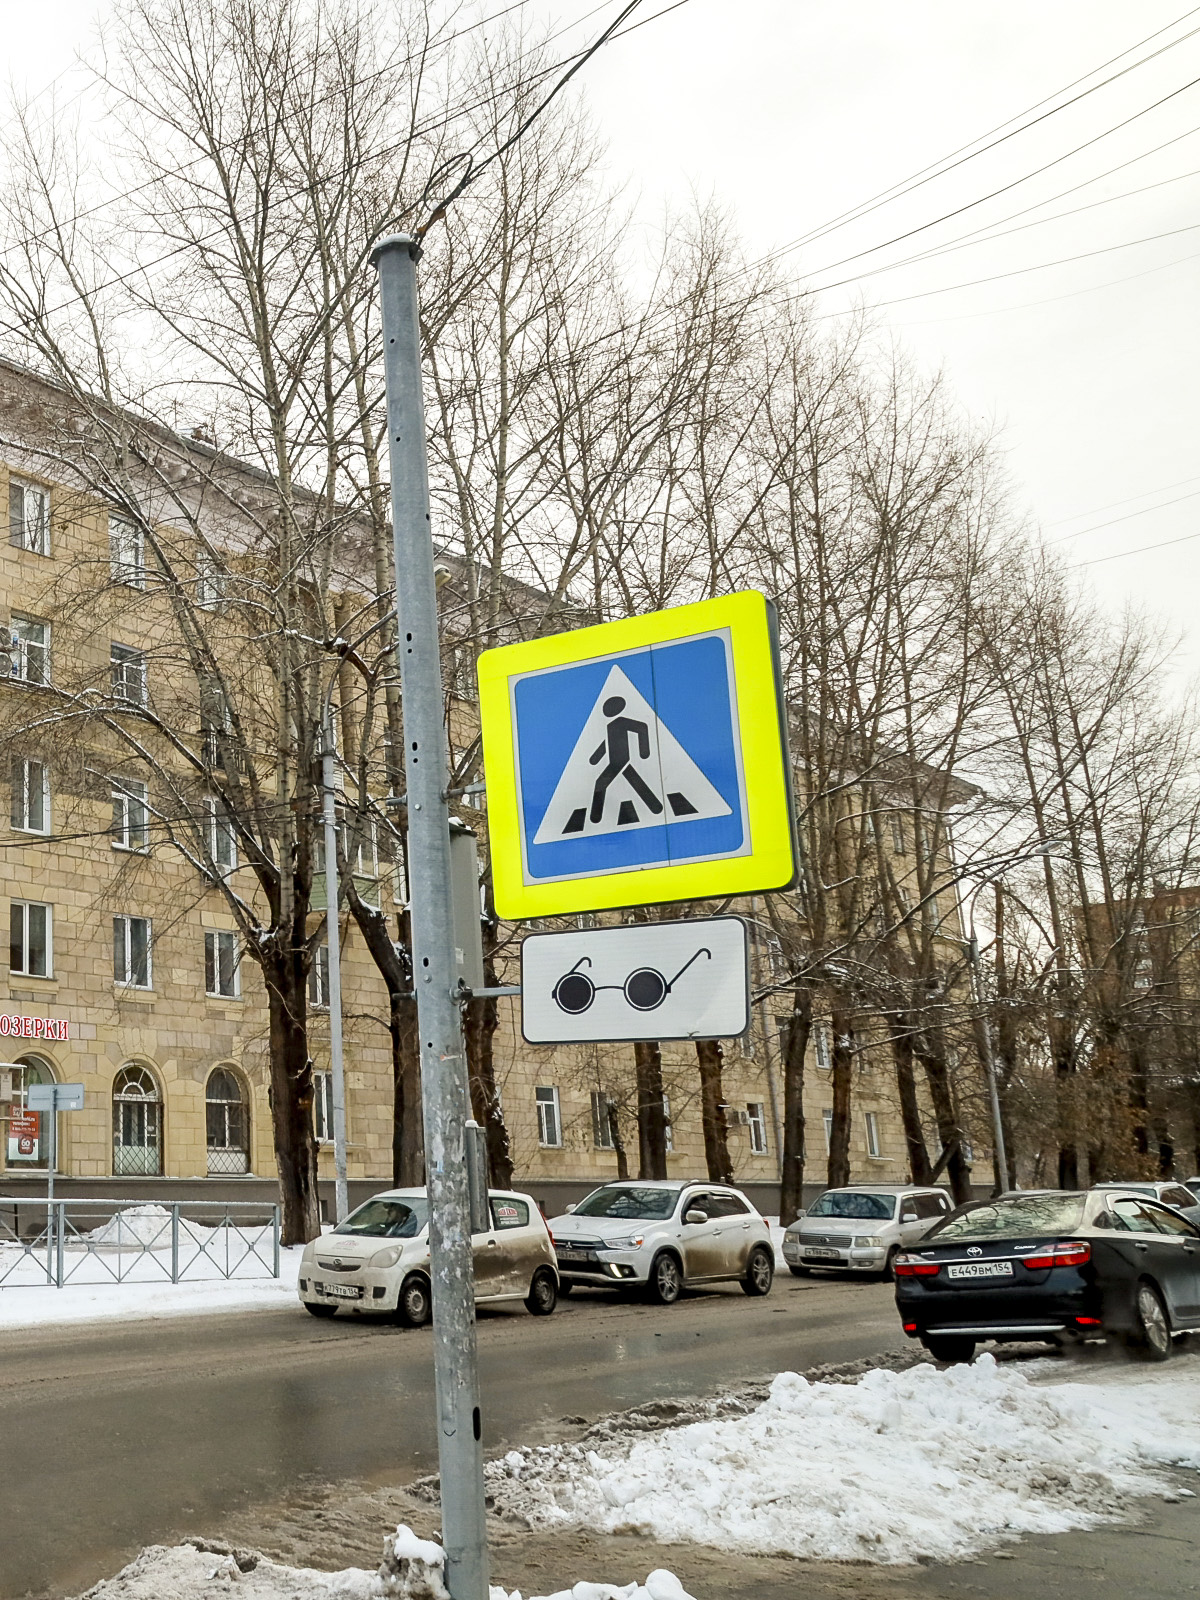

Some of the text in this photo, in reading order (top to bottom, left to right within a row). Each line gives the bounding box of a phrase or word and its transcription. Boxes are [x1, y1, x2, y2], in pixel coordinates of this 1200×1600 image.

[0, 1015, 68, 1041] ОЗЕРКИ
[951, 1263, 1011, 1277] Е449ВМ 154
